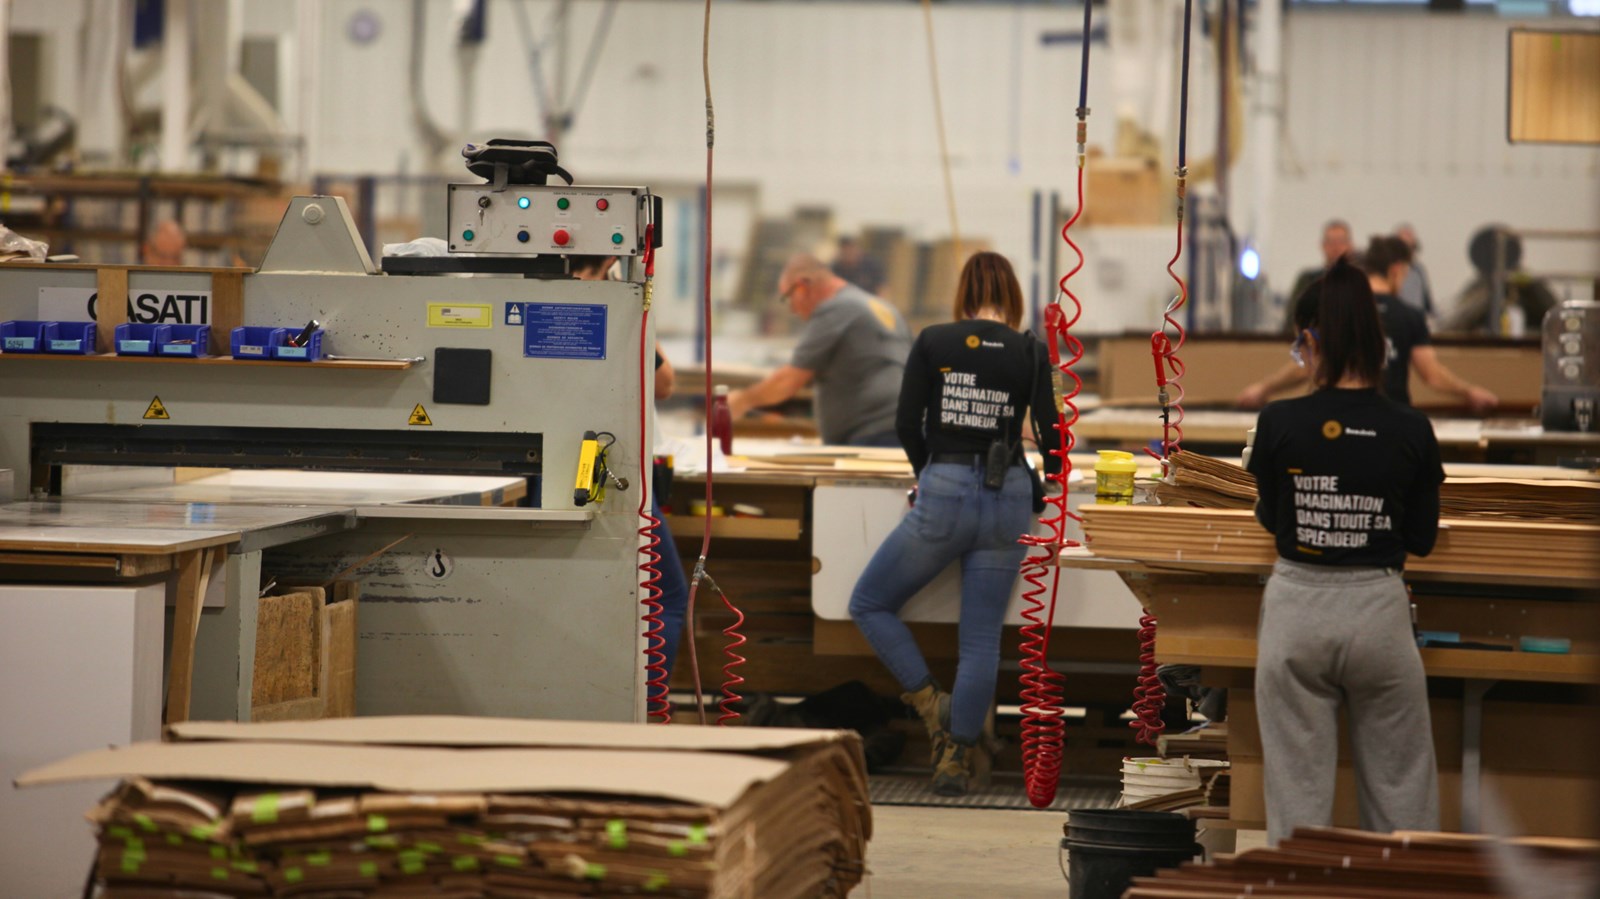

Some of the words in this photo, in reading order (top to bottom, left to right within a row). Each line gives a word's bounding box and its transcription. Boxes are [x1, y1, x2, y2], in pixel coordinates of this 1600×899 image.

[944, 372, 976, 386] VOTRE
[942, 385, 1009, 404] IMAGINATION
[941, 398, 969, 412] DANS
[971, 401, 1001, 416] TOUTE
[1003, 405, 1015, 417] SA
[940, 411, 998, 429] SPLENDEUR.
[1294, 475, 1338, 492] VOTRE
[1294, 492, 1384, 513] IMAGINATION
[1296, 509, 1331, 528] DANS
[1333, 513, 1372, 530] TOUTE
[1373, 515, 1392, 530] SA
